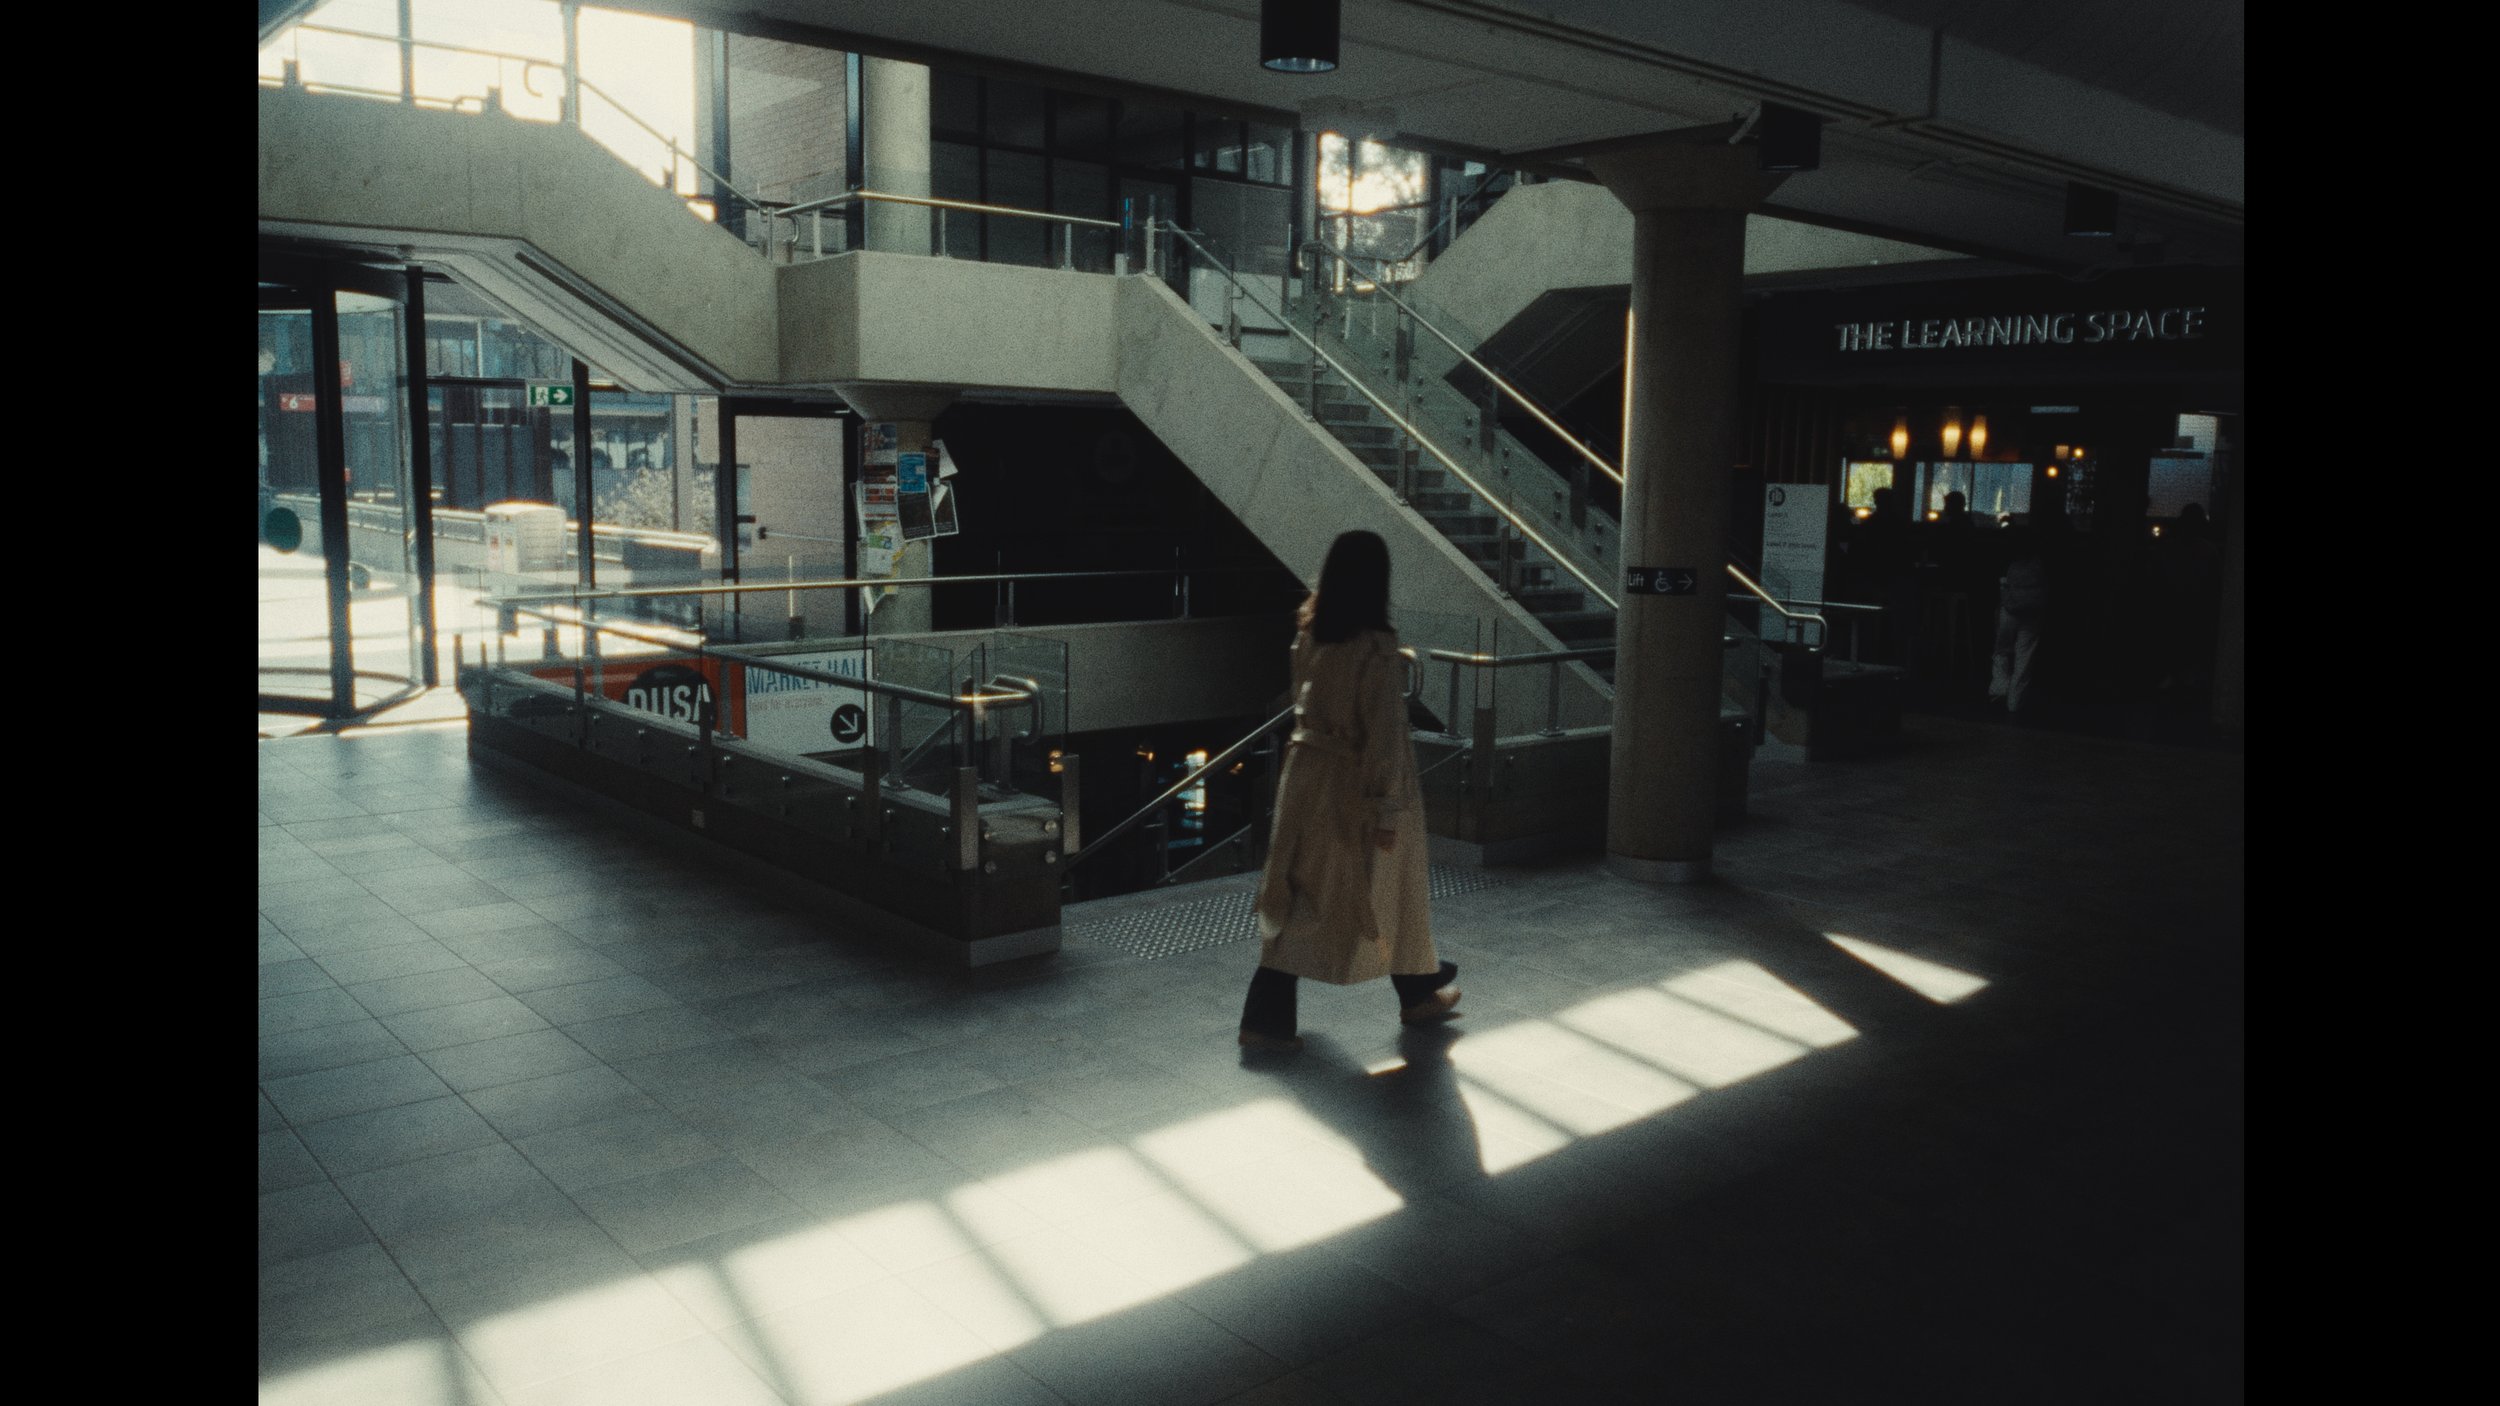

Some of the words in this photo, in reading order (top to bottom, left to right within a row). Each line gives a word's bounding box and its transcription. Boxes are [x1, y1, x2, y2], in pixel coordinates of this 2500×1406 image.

[1834, 320, 1895, 352] THE
[1901, 312, 2075, 350] LEARNING
[2083, 305, 2207, 343] SPACE
[1627, 572, 1645, 588] Lift
